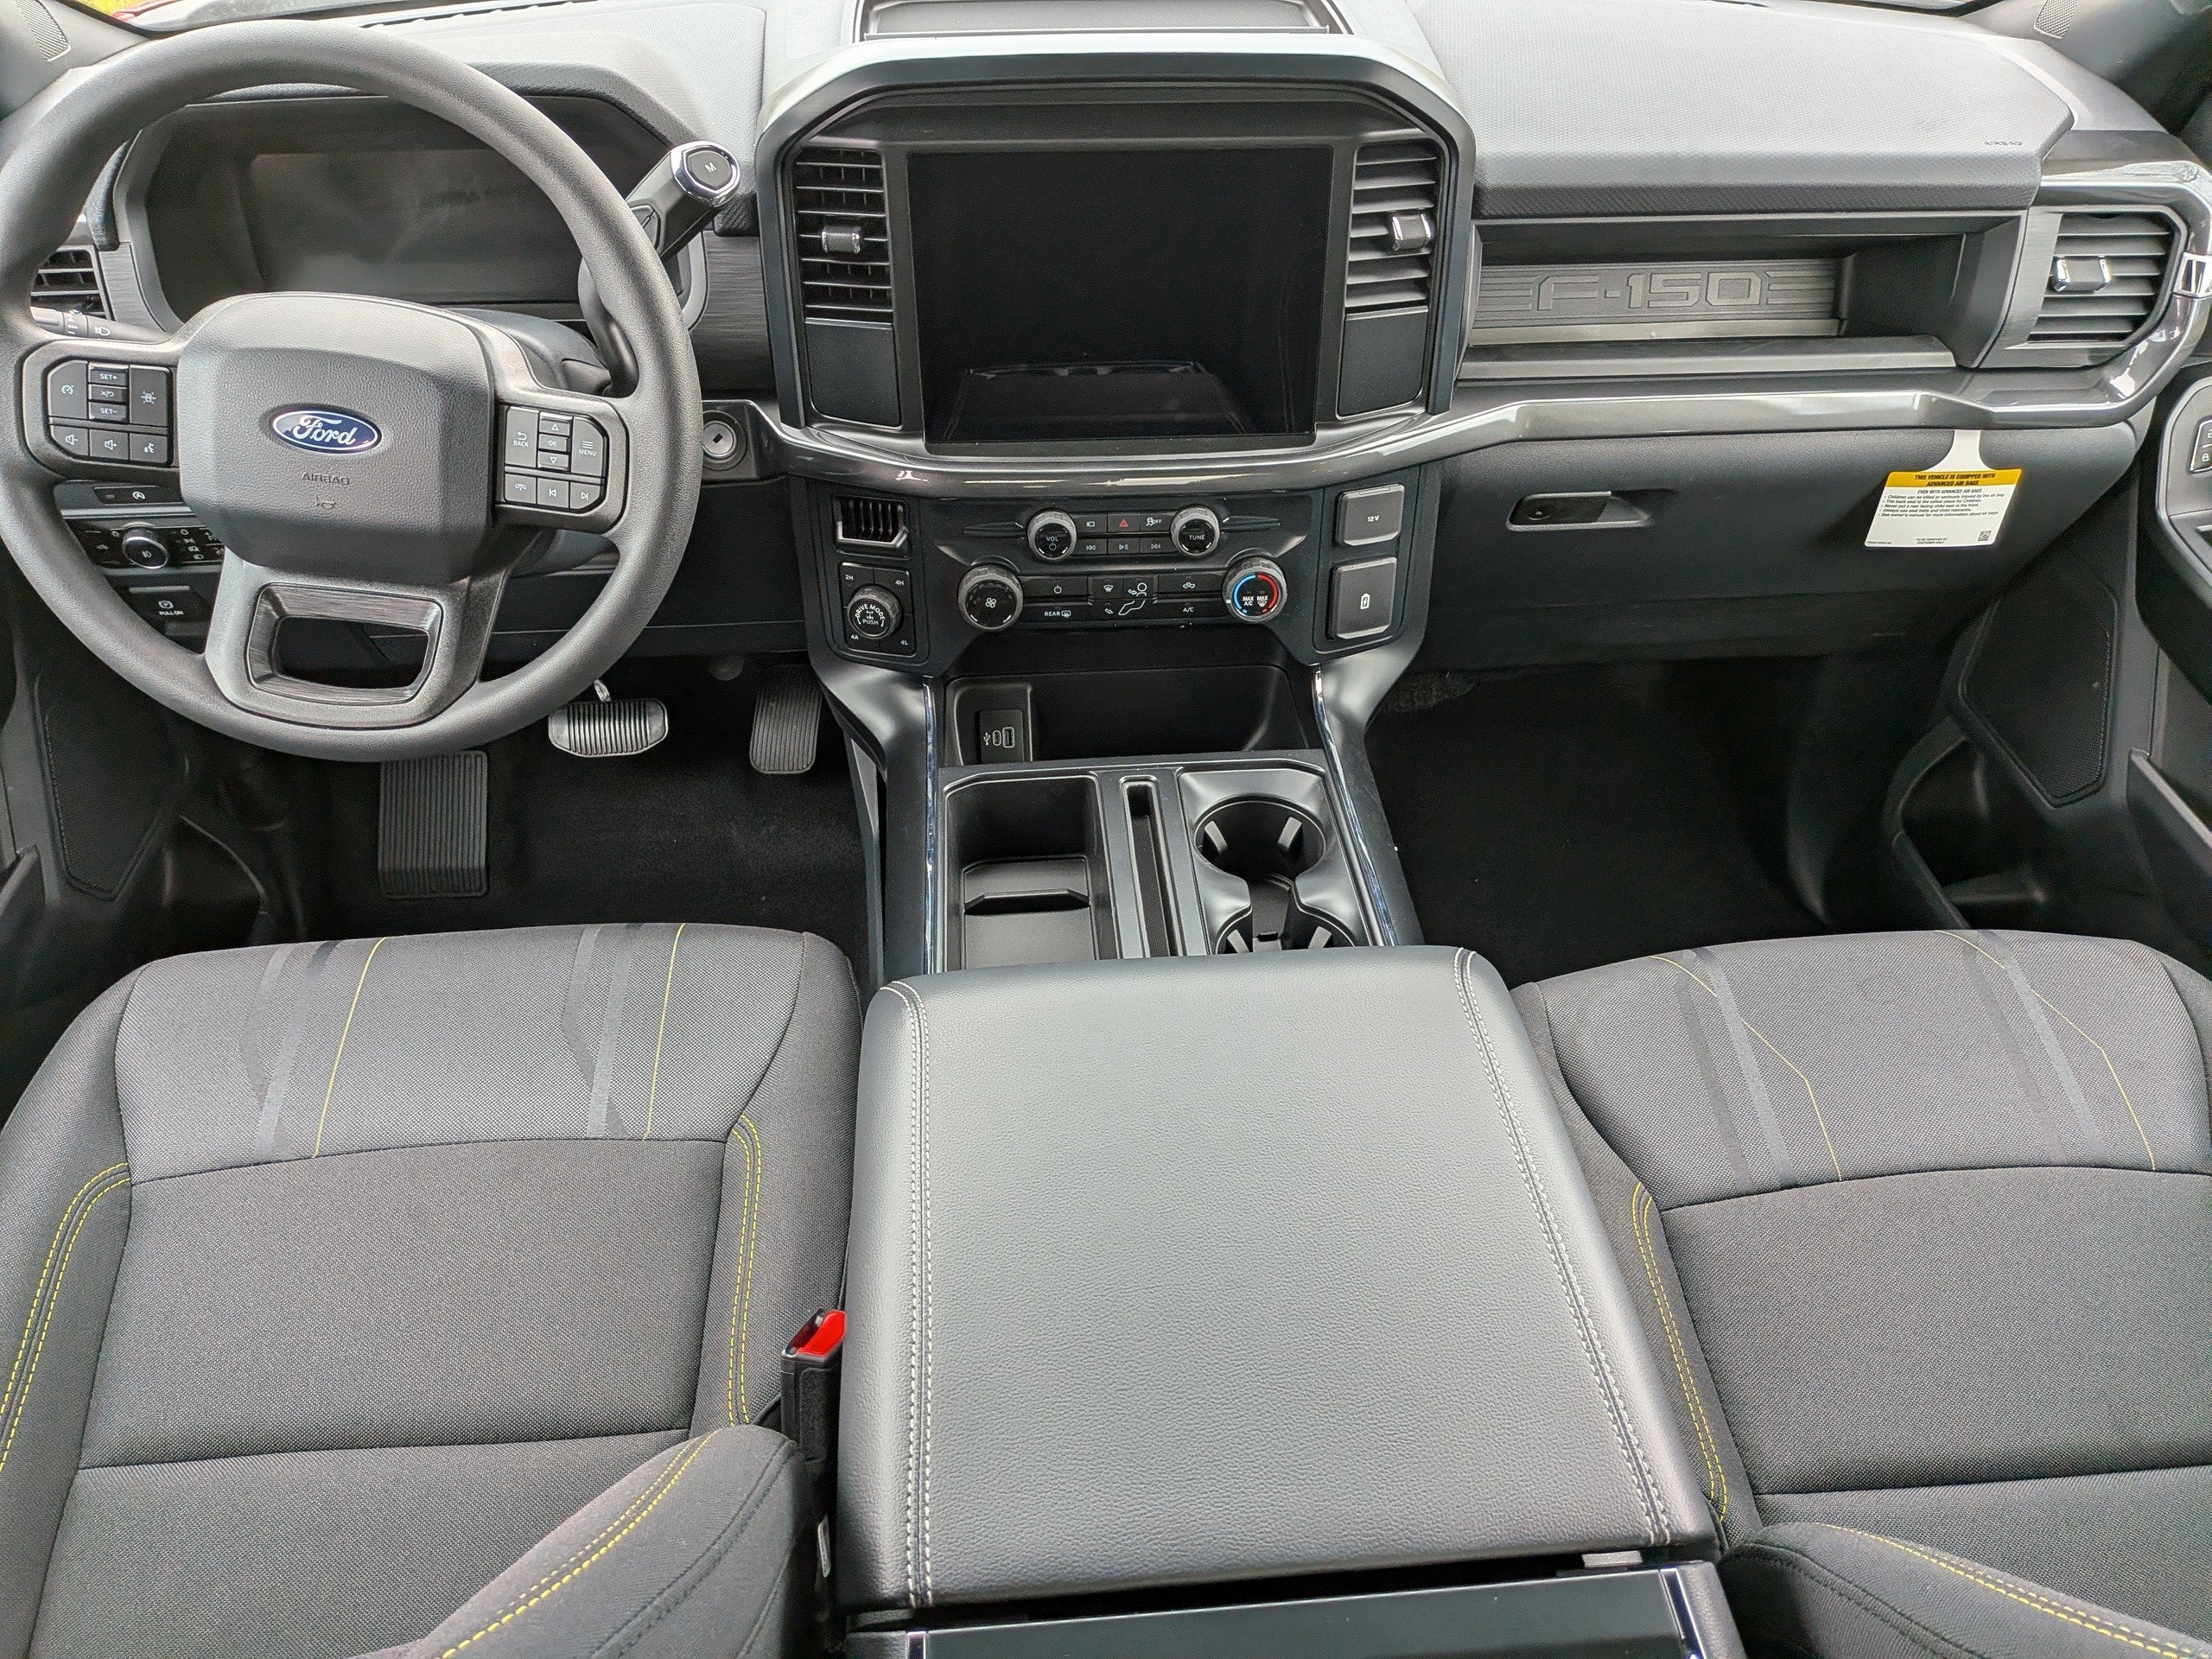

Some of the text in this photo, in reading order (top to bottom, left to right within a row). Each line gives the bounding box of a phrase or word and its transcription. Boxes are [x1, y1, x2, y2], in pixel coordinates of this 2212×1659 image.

[704, 162, 717, 173] M
[1536, 271, 1763, 312] F-150
[292, 415, 358, 445] Ford
[302, 473, 350, 486] AIRBAG
[855, 603, 886, 620] DRIVE MODE
